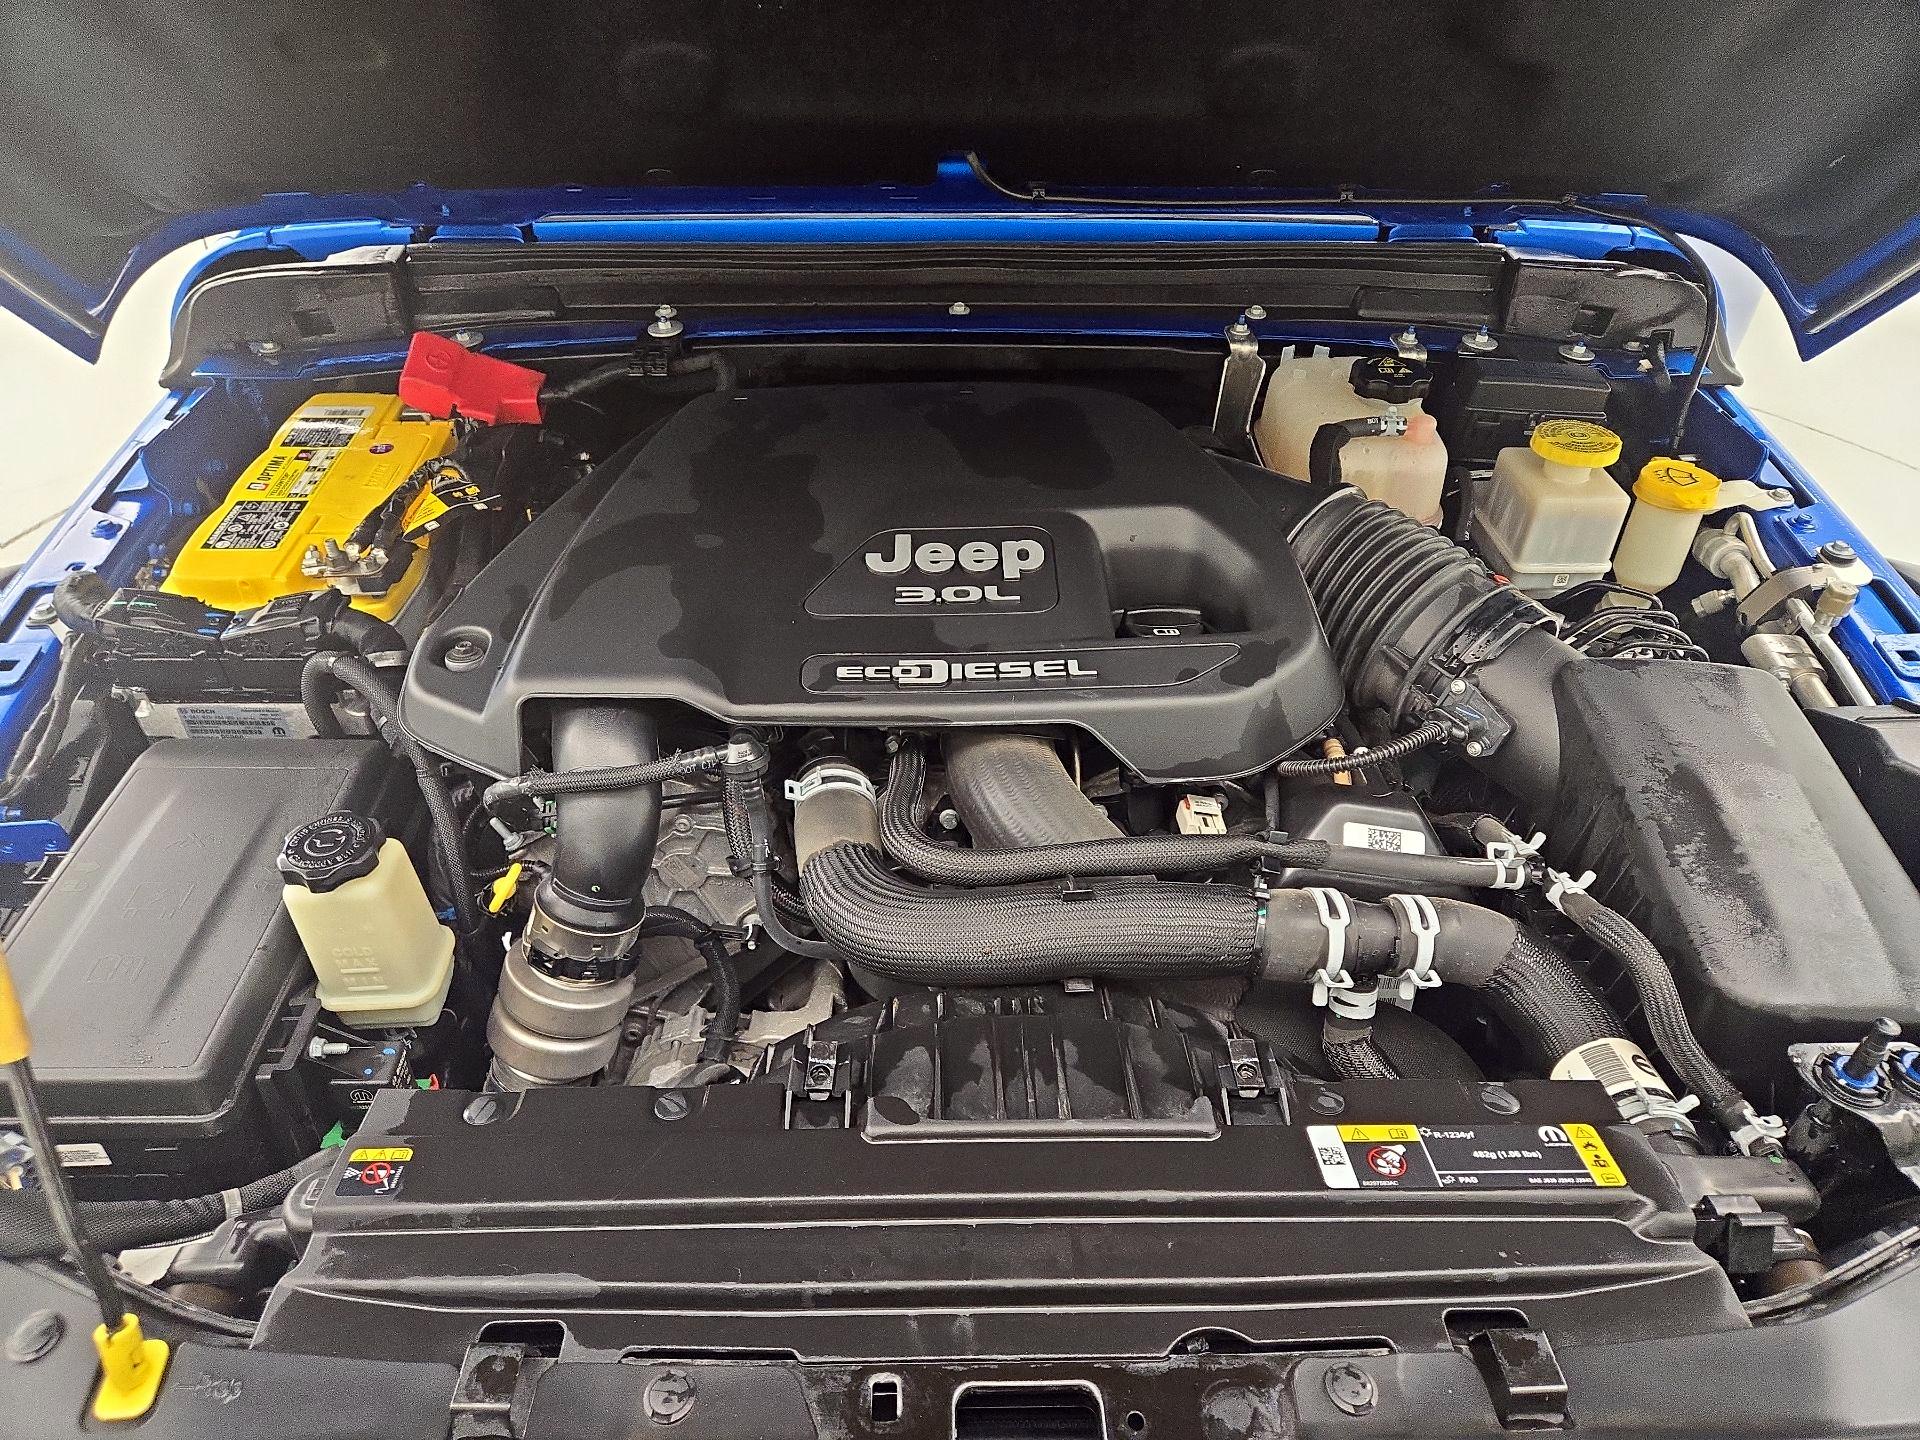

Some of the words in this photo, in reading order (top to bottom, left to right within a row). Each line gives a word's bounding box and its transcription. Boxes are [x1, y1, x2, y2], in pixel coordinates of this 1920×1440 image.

[256, 455, 288, 482] OPTIMA
[865, 533, 1046, 582] Jeep
[894, 585, 1021, 606] 3.0L
